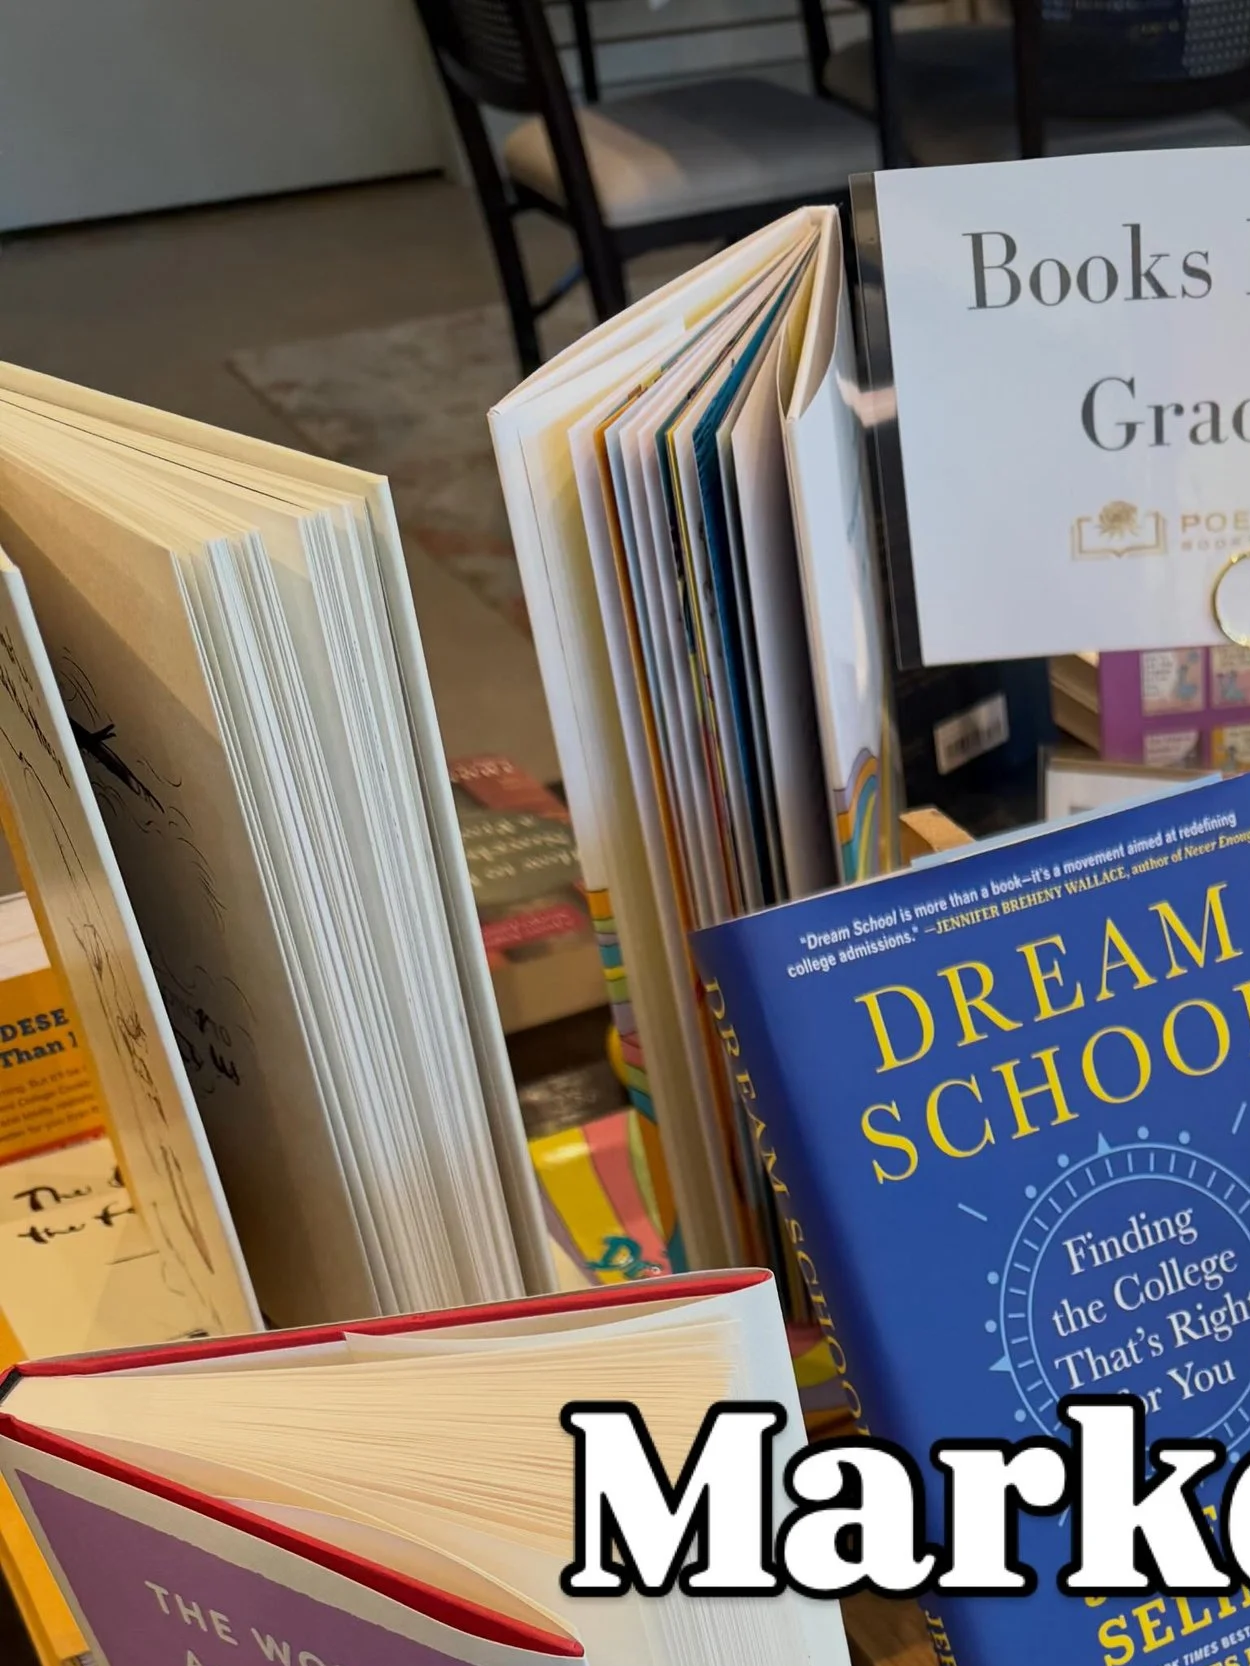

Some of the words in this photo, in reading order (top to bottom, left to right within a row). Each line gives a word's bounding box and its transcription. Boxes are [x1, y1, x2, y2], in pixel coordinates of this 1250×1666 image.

[961, 222, 1213, 312] Books
[1180, 508, 1250, 533] POE
[786, 953, 838, 978] college
[1001, 889, 1063, 915] BREHENY
[1063, 865, 1132, 895] WALLACE,
[1131, 854, 1170, 876] author
[1171, 848, 1184, 864] of
[1184, 838, 1218, 859] Never
[852, 911, 899, 936] School
[899, 908, 913, 923] is
[914, 899, 949, 918] more
[949, 887, 979, 907] than
[980, 886, 991, 899] a
[1053, 863, 1062, 878] a
[1062, 845, 1126, 876] movement
[1127, 831, 1164, 857] aimed
[1164, 827, 1178, 844] at
[1179, 809, 1238, 840] redefining
[855, 881, 1243, 1073] DREAM
[703, 976, 791, 1198] DREAM
[1062, 1207, 1199, 1275] Finding
[1051, 1298, 1107, 1338] the
[1112, 1248, 1239, 1312] College
[1166, 1358, 1238, 1401] You
[144, 1581, 239, 1646] THE
